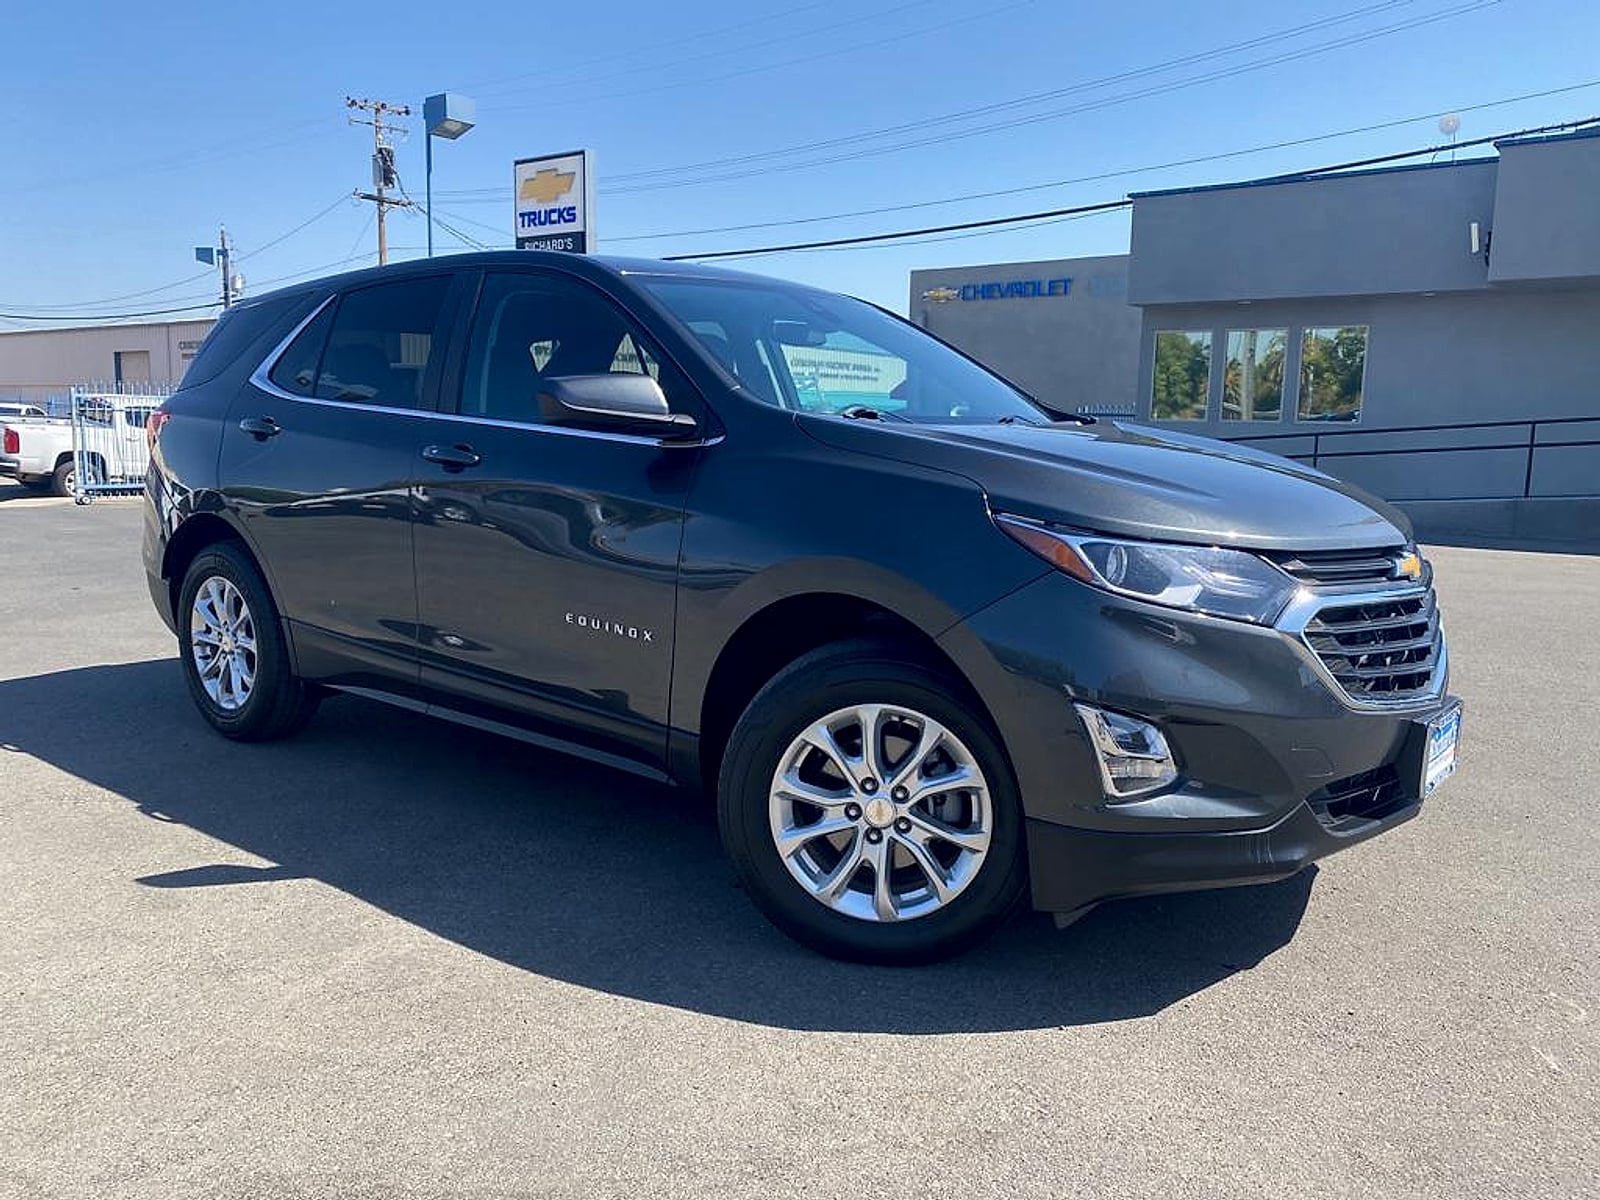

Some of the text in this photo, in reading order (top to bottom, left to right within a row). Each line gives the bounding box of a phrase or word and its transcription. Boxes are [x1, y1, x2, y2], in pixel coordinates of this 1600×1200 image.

[518, 206, 576, 228] TRUCKS
[961, 277, 1073, 301] CHEVROLET
[564, 612, 653, 641] EQUINOX
